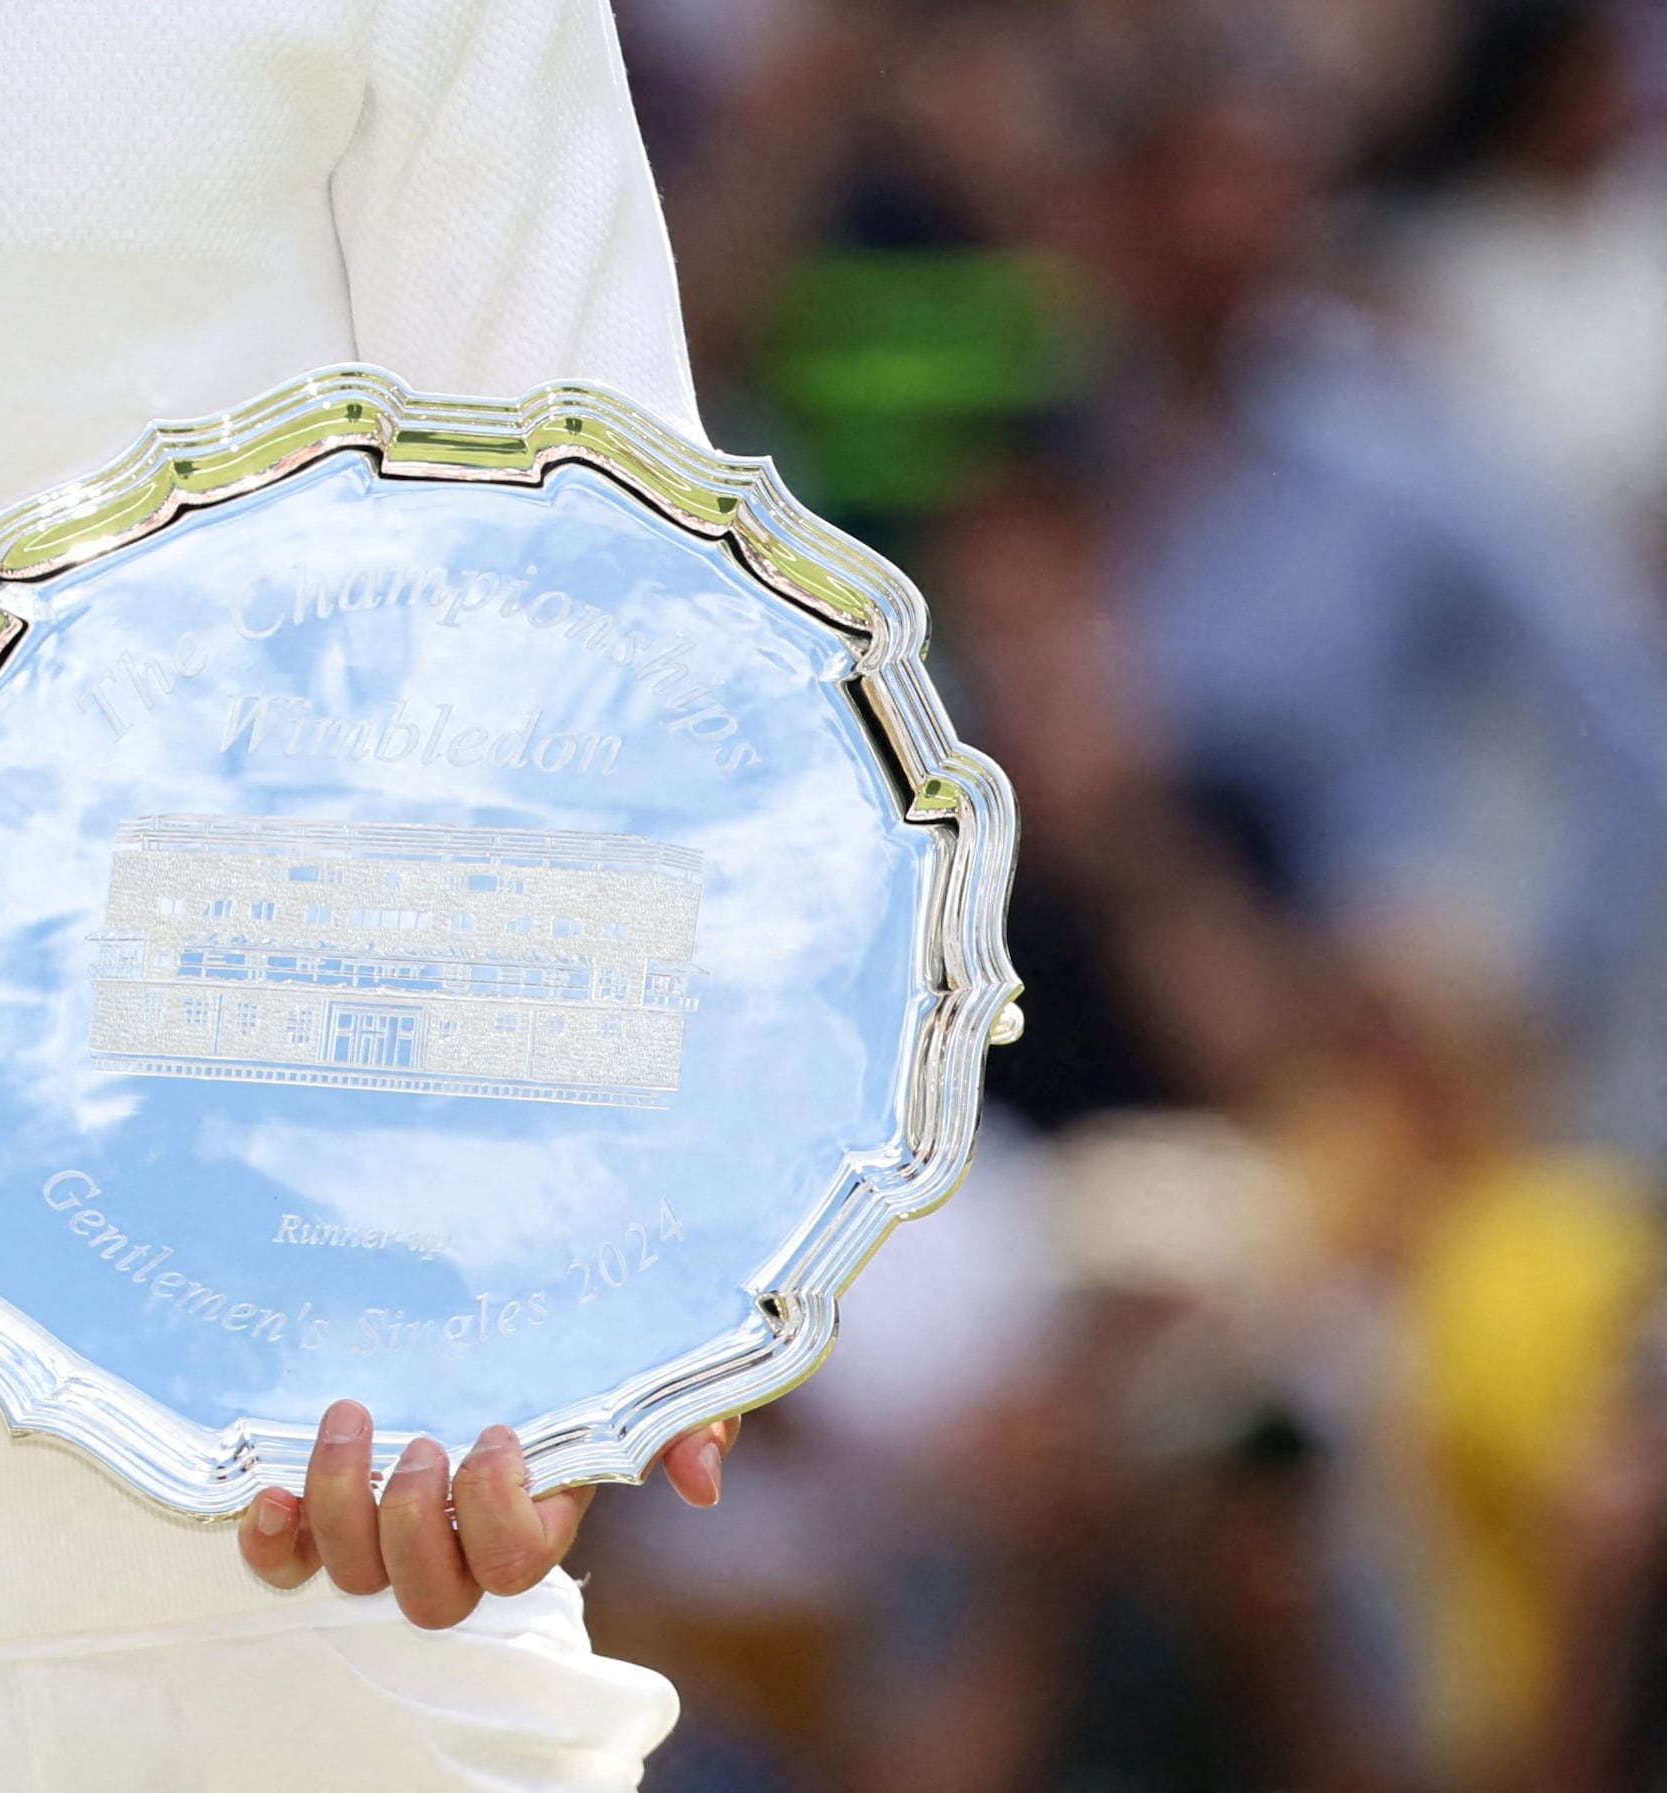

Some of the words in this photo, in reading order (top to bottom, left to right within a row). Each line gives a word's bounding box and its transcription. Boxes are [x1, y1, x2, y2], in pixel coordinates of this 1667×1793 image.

[76, 631, 209, 743] The
[229, 560, 762, 772] Championships
[220, 693, 624, 775] Wimbledon
[43, 1169, 331, 1350] Gentlemen's
[352, 1289, 548, 1360] Singles
[567, 1197, 685, 1305] 2024
[272, 1213, 450, 1261] Runner-up
